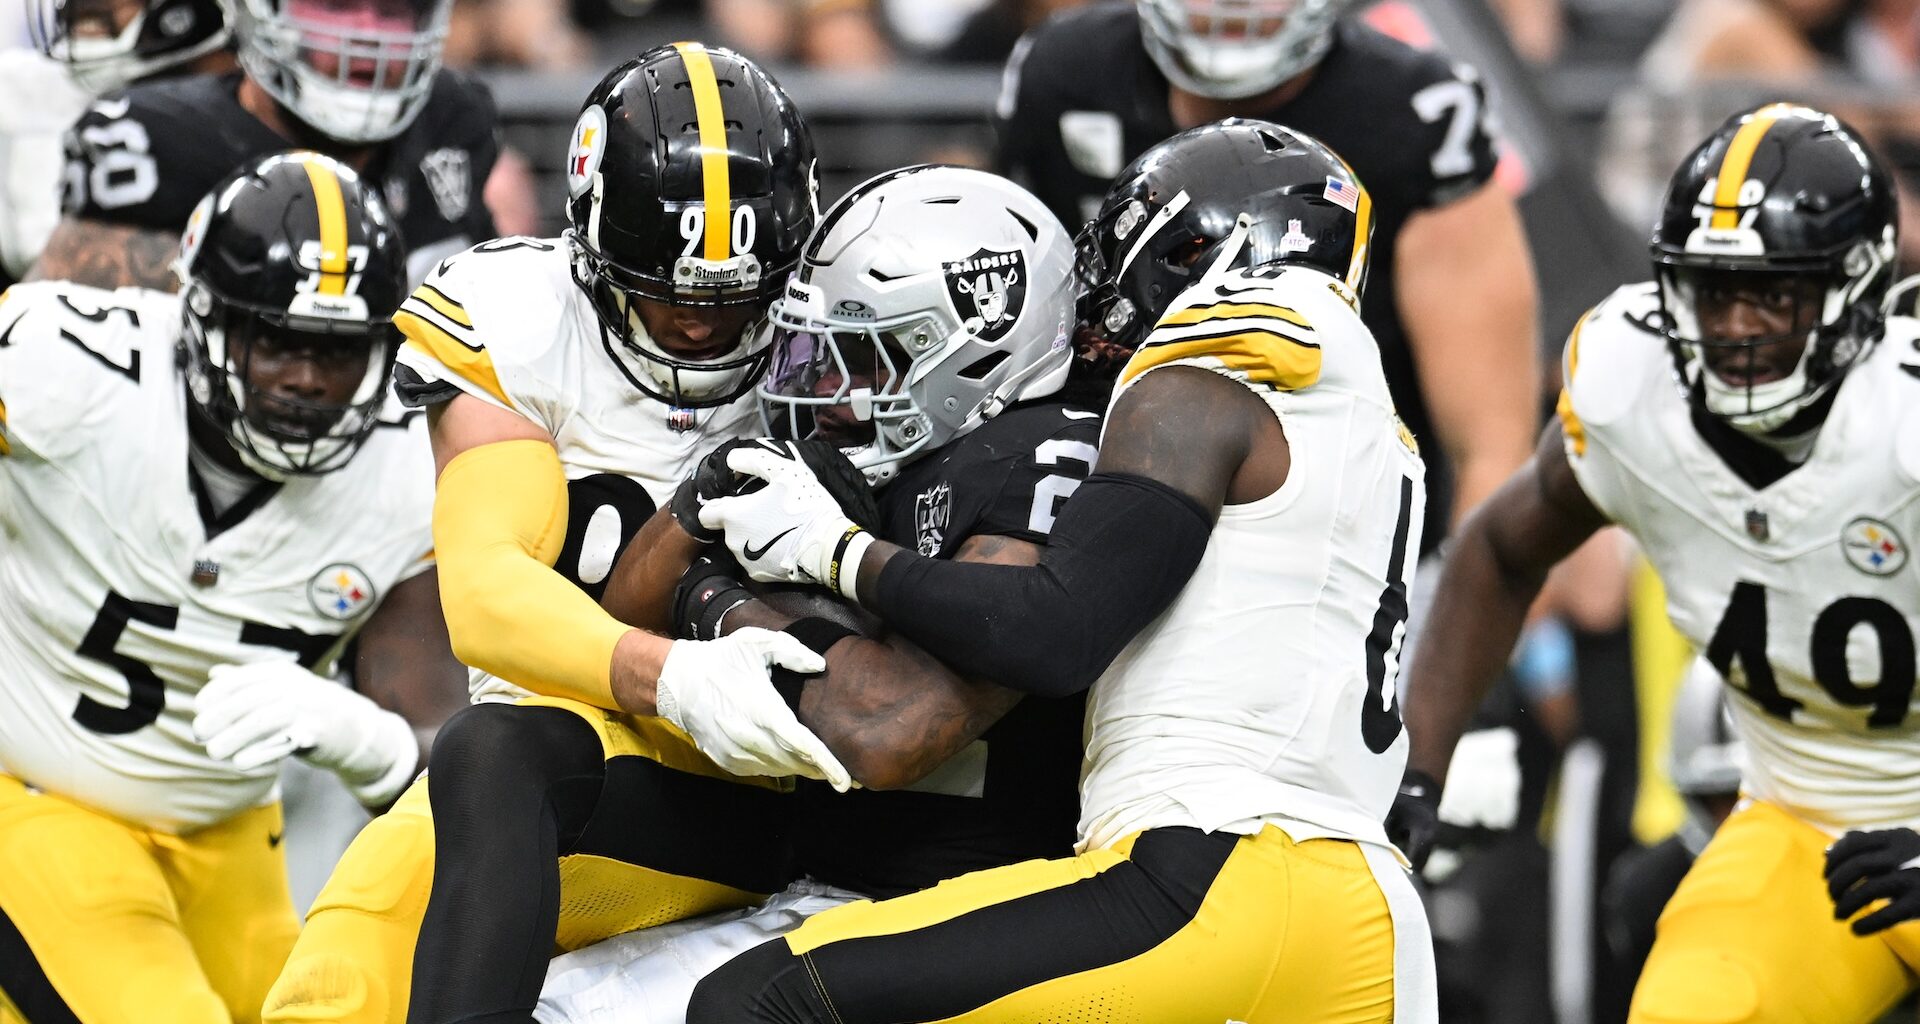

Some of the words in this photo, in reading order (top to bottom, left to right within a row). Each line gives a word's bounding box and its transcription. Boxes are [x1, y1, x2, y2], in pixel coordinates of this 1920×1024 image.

[1411, 81, 1500, 178] 7
[679, 204, 757, 257] 90
[694, 265, 739, 280] Steelers
[950, 252, 1019, 275] RAIDERS
[833, 310, 873, 319] OAKLEY
[1706, 579, 1916, 729] 49
